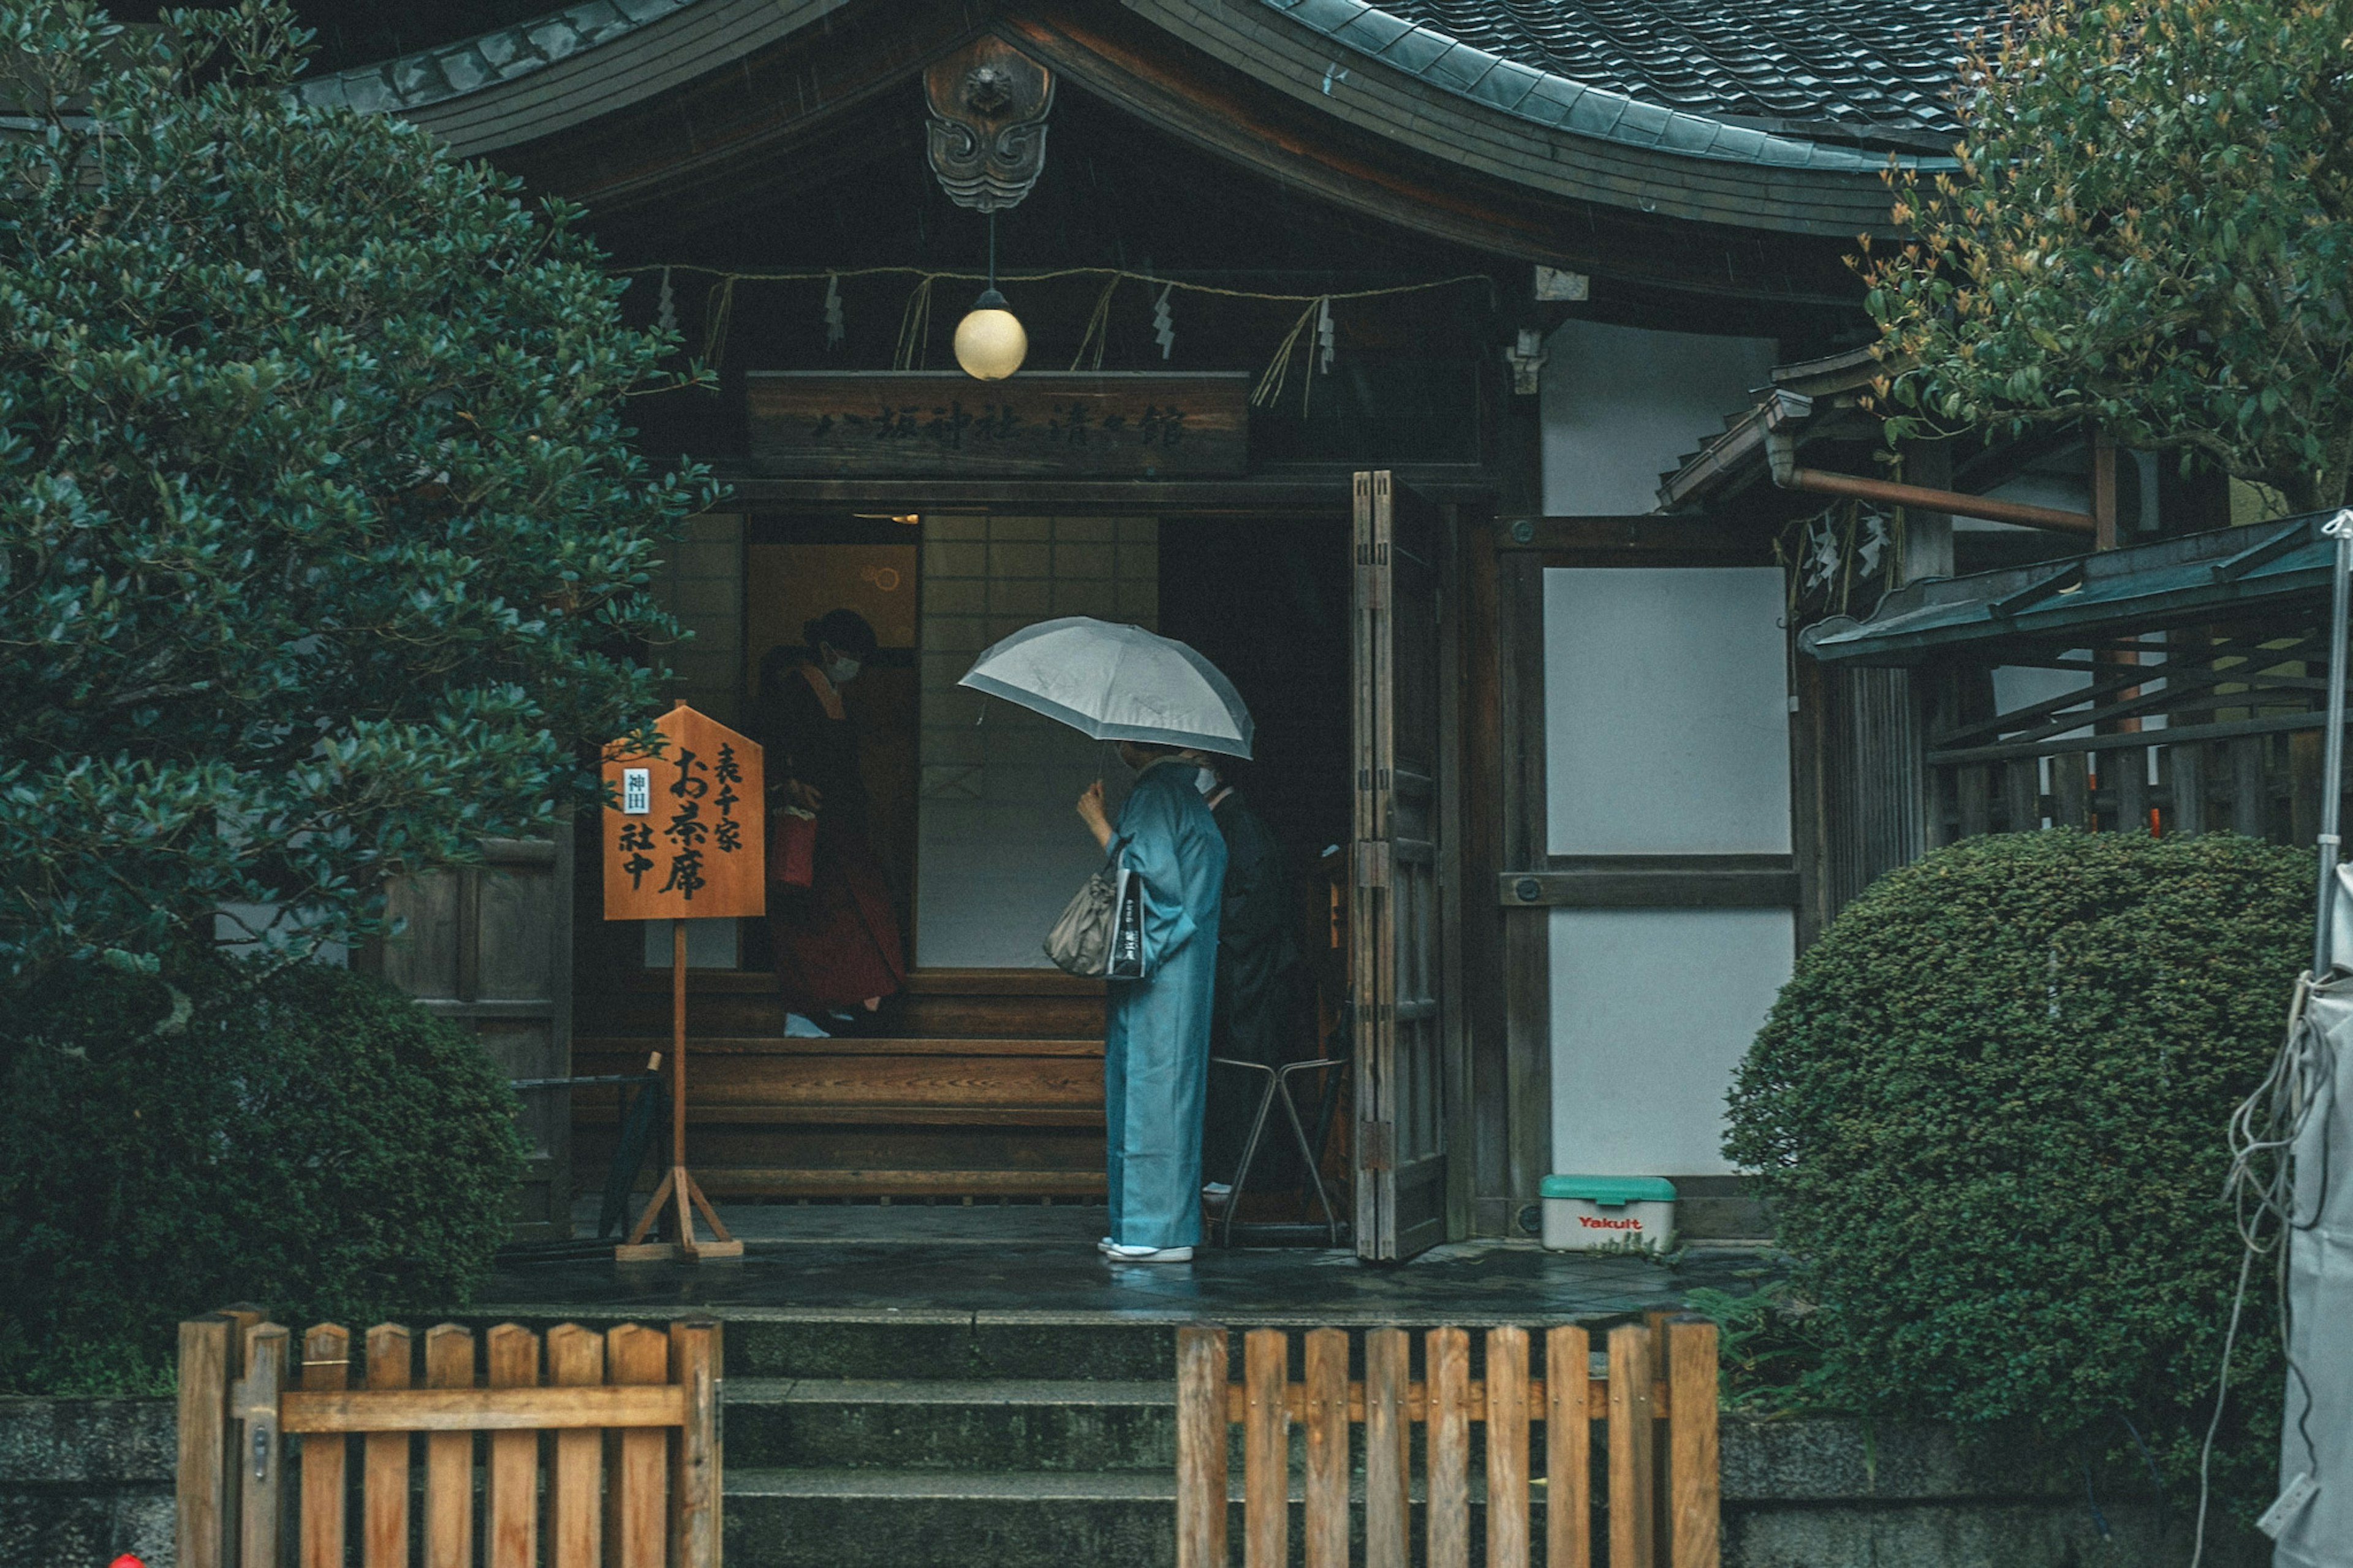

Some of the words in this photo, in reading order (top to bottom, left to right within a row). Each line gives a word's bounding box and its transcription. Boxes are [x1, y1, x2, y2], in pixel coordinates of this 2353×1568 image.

[629, 774, 646, 809] 神田
[658, 747, 708, 900] お茶席
[714, 742, 743, 852] 表千家
[619, 822, 656, 890] 社中
[1578, 1216, 1643, 1230] Yakult
